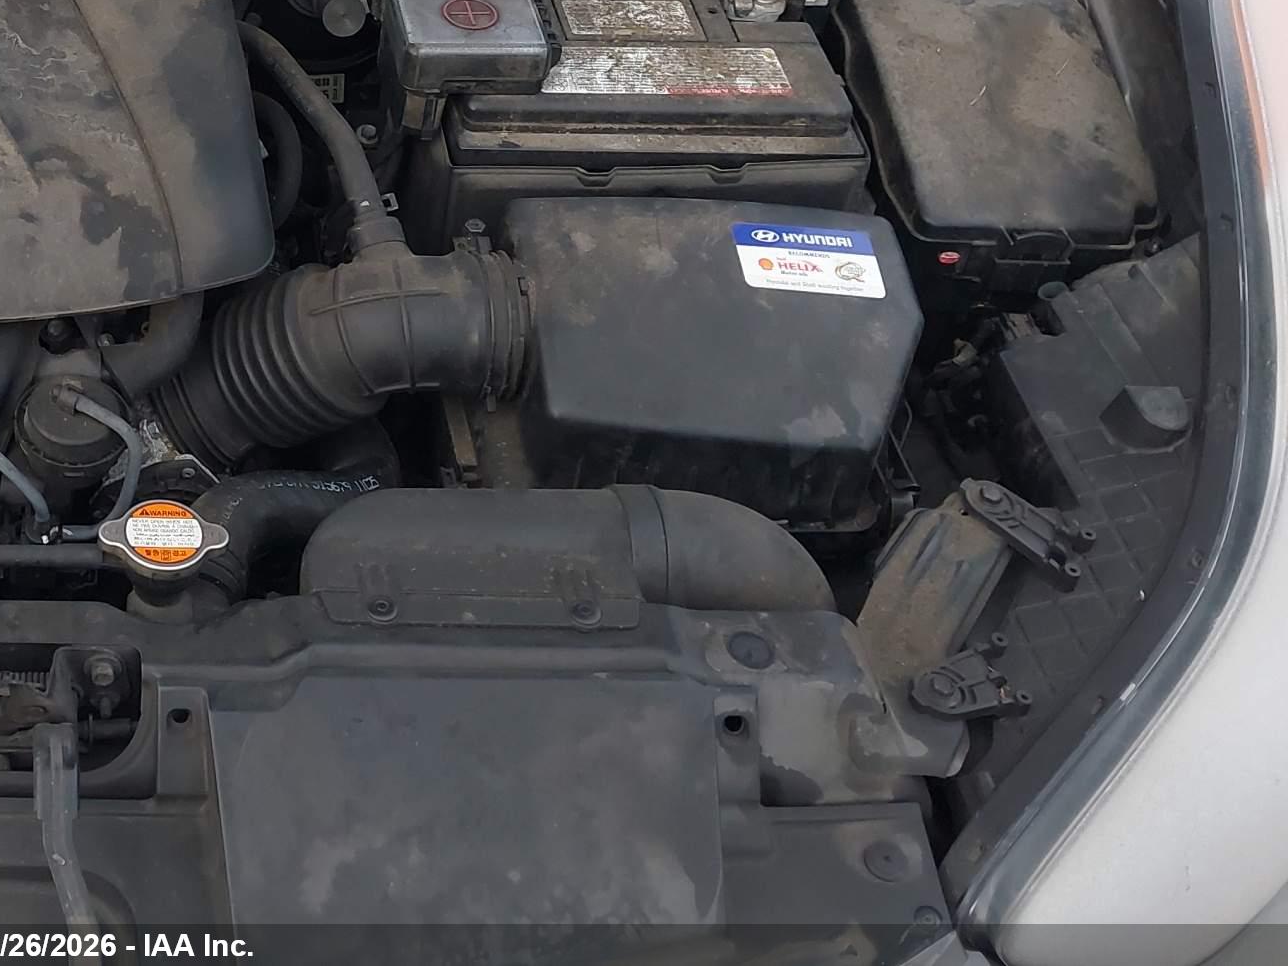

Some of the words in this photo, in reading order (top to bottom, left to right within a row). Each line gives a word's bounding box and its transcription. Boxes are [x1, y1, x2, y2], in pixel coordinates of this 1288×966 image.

[782, 233, 853, 248] HYUNDAI
[777, 261, 823, 273] HELIX
[149, 509, 187, 517] WARNING
